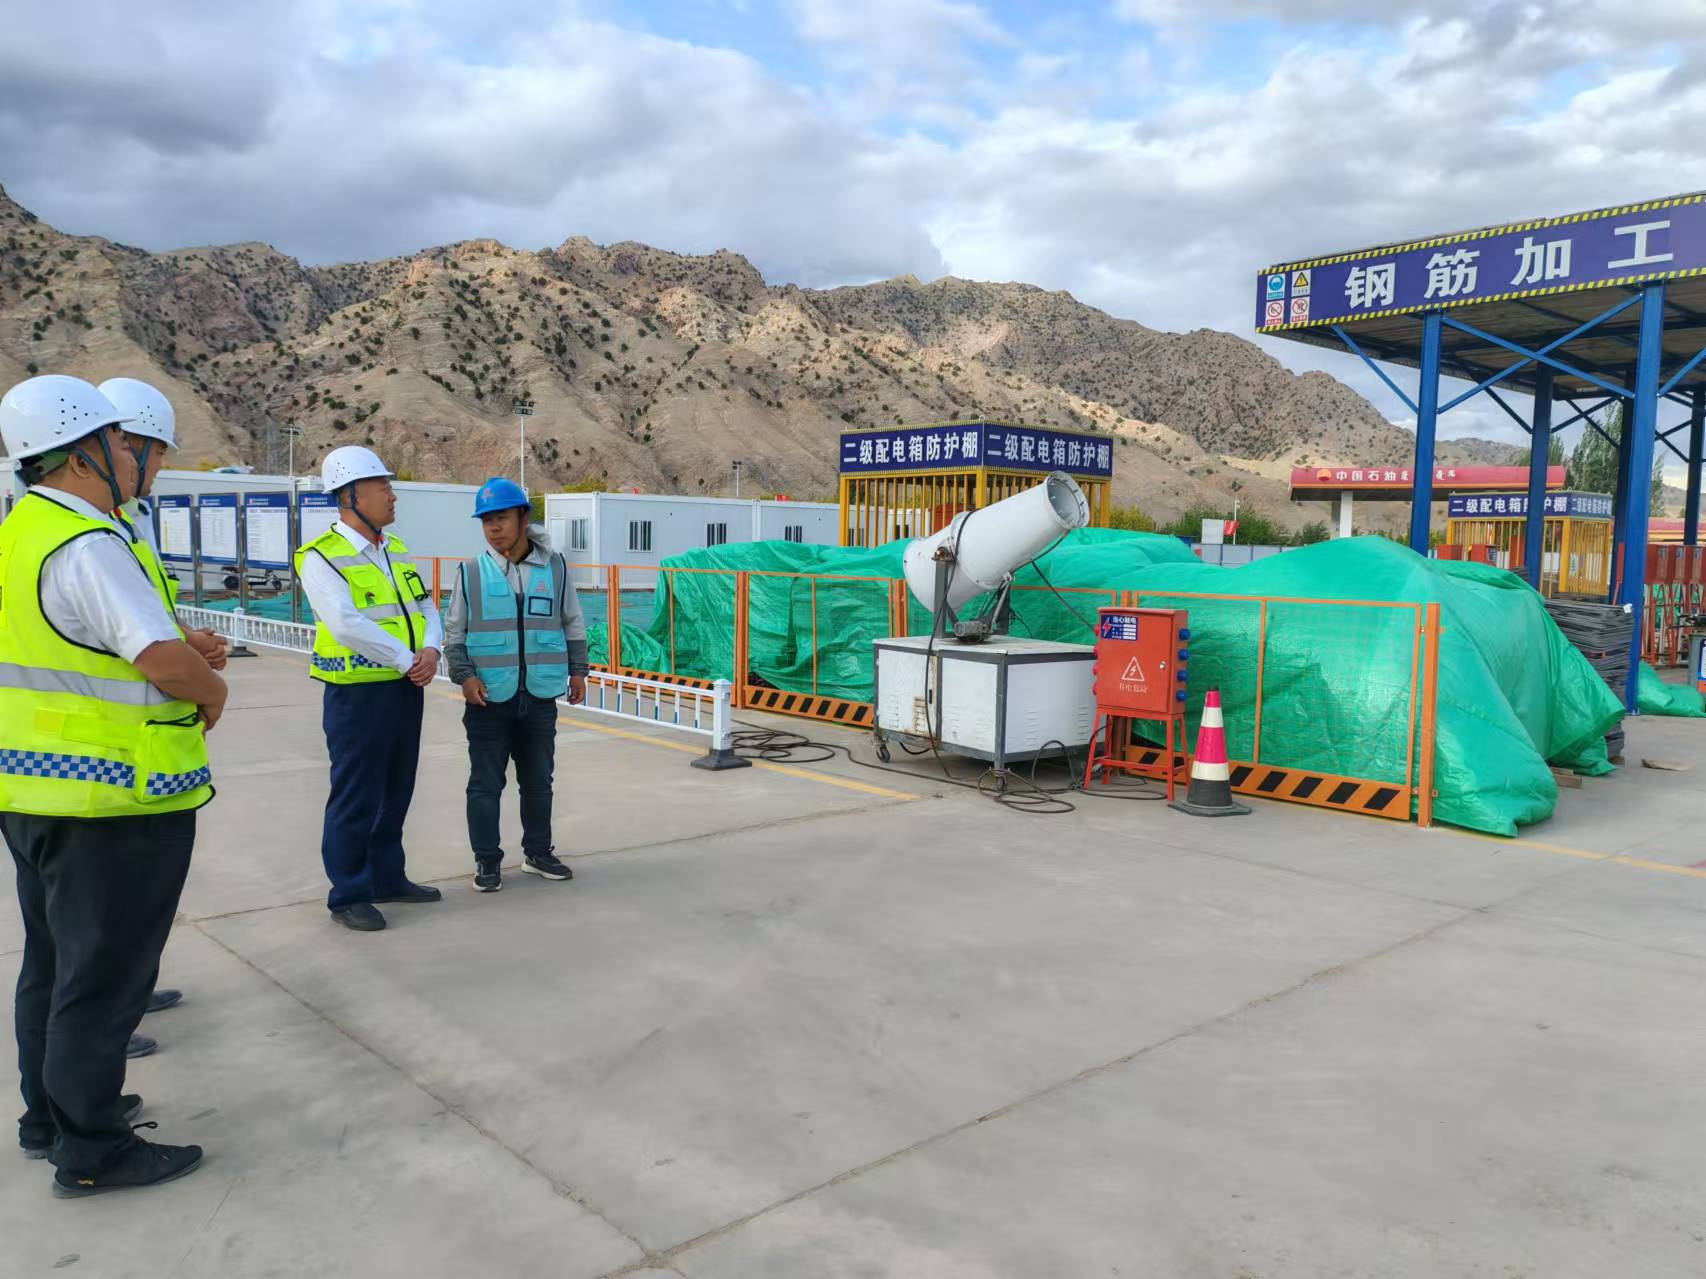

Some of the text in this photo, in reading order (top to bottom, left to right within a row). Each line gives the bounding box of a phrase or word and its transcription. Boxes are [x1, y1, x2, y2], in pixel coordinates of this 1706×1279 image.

[1345, 220, 1673, 308] 钢筋加工
[843, 431, 978, 464] 二级配电箱防护棚
[987, 433, 1110, 469] 二级配电箱防护棚
[1336, 470, 1396, 481] 中国石油
[1451, 496, 1567, 513] 二级配电箱护棚
